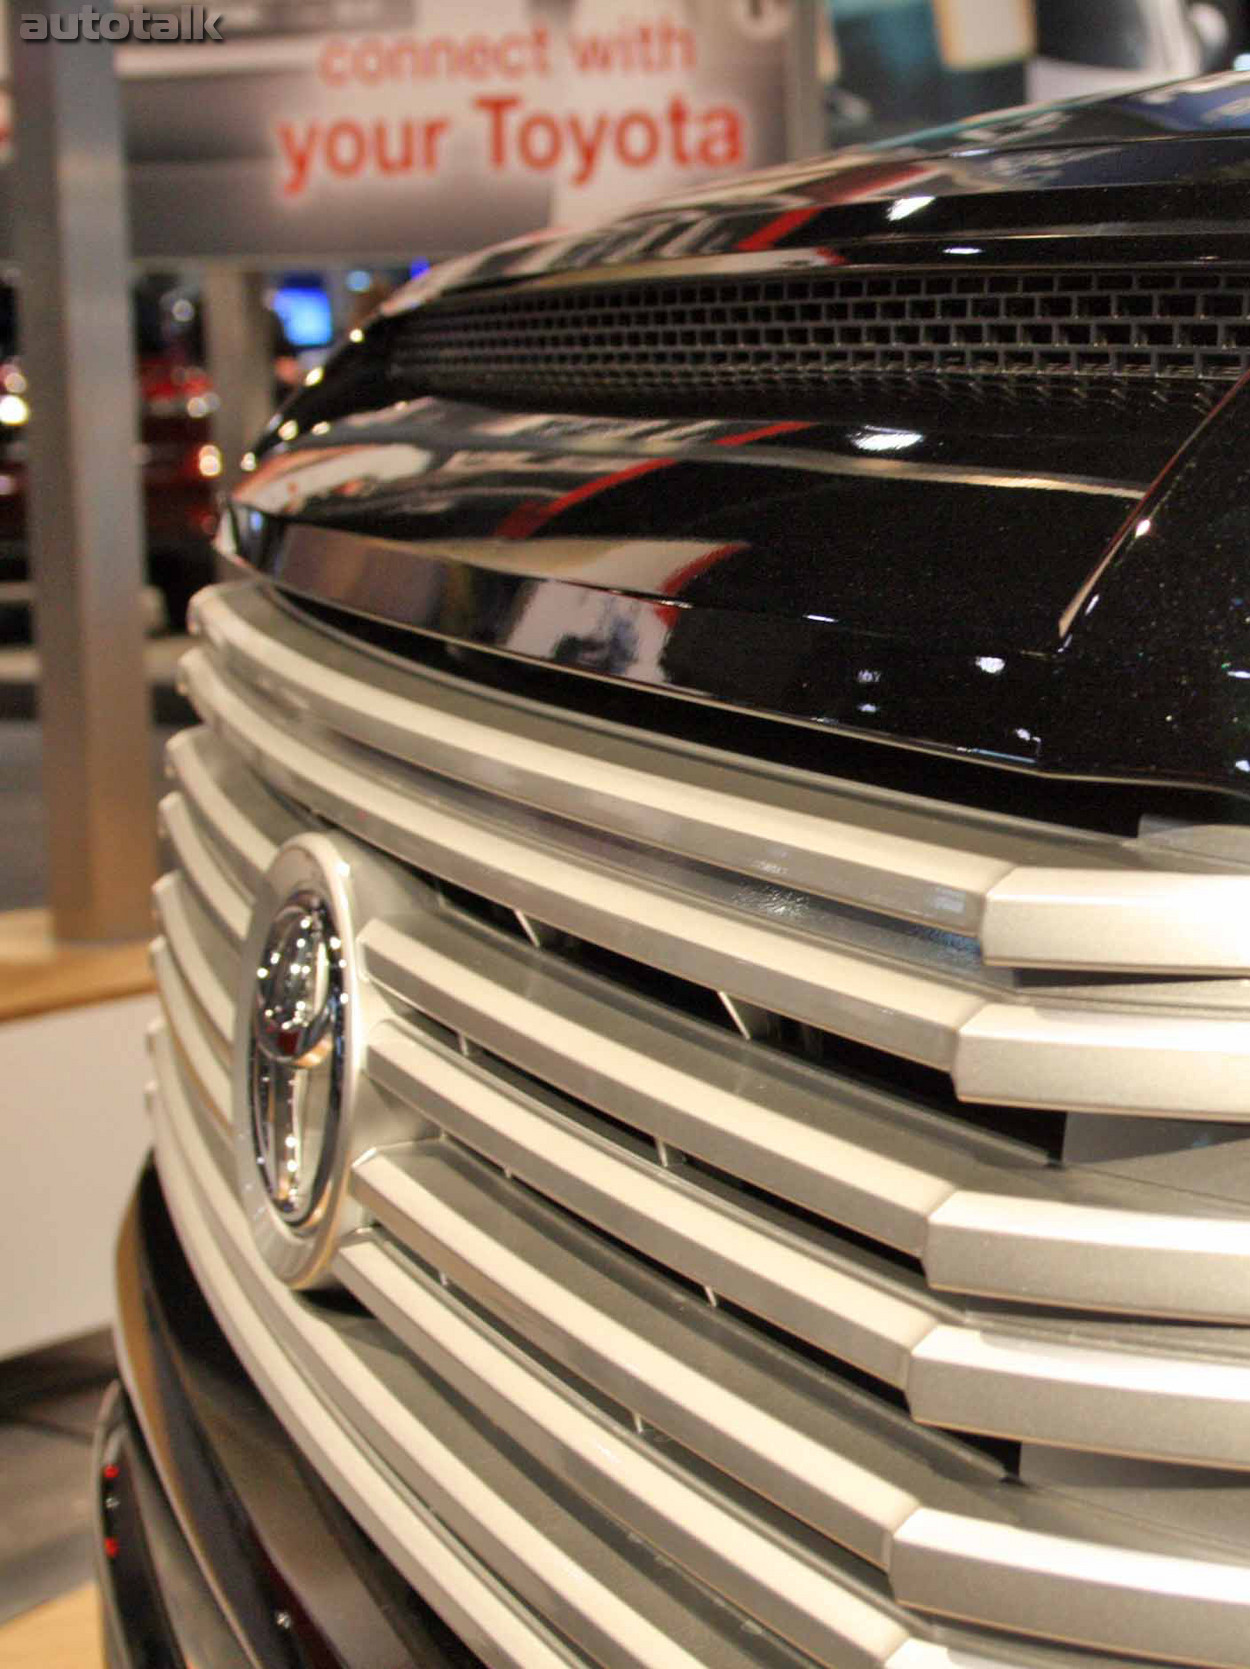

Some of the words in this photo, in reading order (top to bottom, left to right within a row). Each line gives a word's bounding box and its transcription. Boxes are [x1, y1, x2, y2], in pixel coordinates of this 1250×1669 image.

[320, 28, 550, 85] connect
[572, 19, 698, 73] with
[276, 113, 449, 195] your
[473, 94, 744, 187] Toyota
